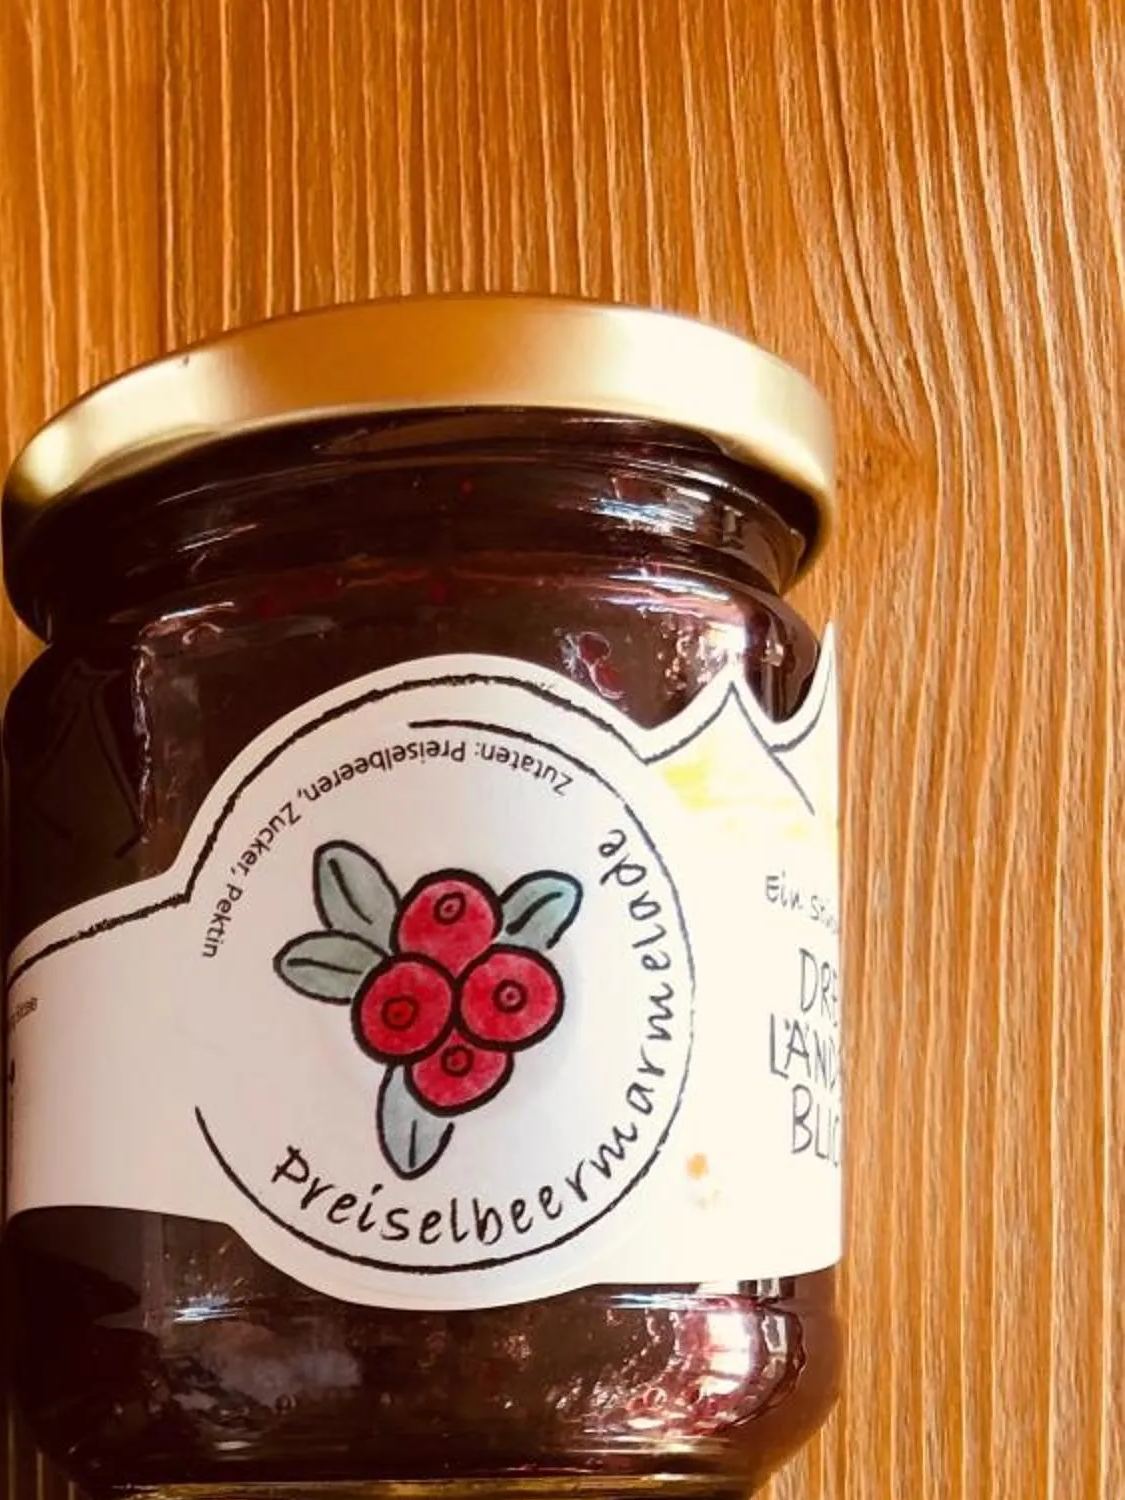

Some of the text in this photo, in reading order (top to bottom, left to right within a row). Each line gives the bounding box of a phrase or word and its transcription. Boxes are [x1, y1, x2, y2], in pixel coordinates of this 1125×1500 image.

[201, 737, 575, 960] Zutaten: Preiselbeeren, Zucker, Pektin
[271, 829, 675, 1245] Preiselbeermarmelade
